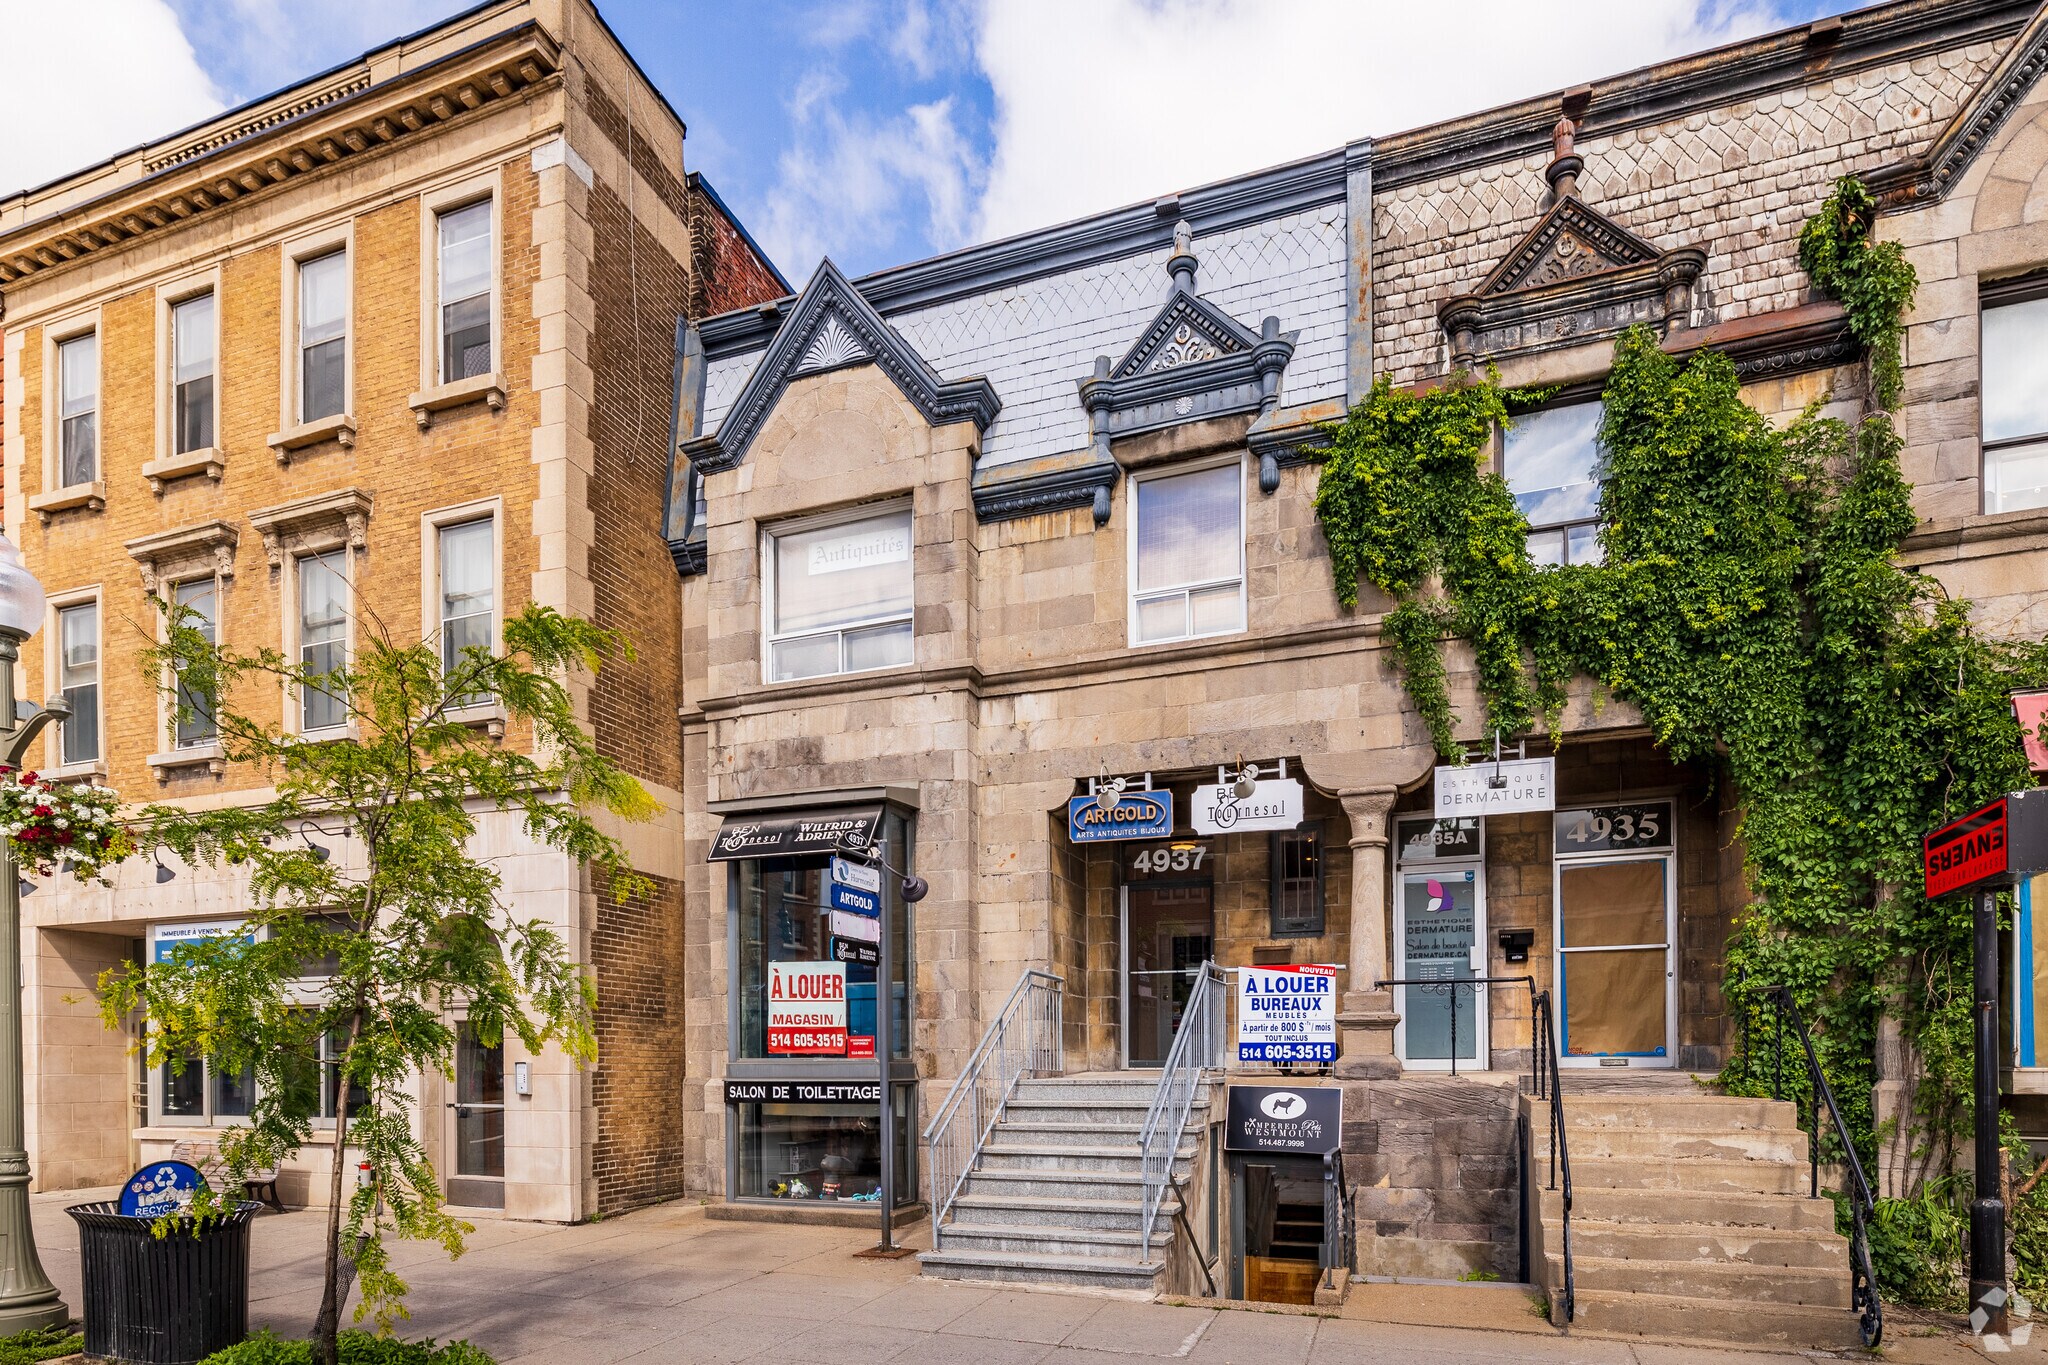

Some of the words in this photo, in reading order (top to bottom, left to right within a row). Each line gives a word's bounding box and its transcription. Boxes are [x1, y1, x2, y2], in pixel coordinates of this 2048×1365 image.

[814, 537, 904, 565] Antiquités
[1443, 773, 1545, 789] ESTHÉQUE
[1216, 787, 1238, 799] BE
[1443, 787, 1546, 806] DERMATURE
[1084, 804, 1157, 824] ARTGOLD
[1207, 800, 1285, 820] Tournesol
[731, 825, 760, 835] BEN
[800, 821, 853, 833] WILFRID
[854, 819, 867, 829] &
[1076, 831, 1094, 839] ARTS
[1140, 826, 1166, 835] BIJOUX
[1566, 813, 1660, 843] 4935
[1409, 830, 1468, 847] 4935A
[1928, 825, 2004, 877] ENVERS
[1133, 847, 1207, 873] 4937
[840, 891, 873, 910] ARTGOLD
[161, 929, 191, 937] IMMEUBLE
[1407, 925, 1473, 935] DERMATURE
[1406, 938, 1430, 951] Salon
[1431, 938, 1440, 950] de
[1407, 951, 1468, 959] DERMATURE.CA
[1299, 966, 1335, 976] NOUVEAU
[770, 968, 783, 999] À
[788, 974, 844, 999] LOUER
[1245, 974, 1258, 993] À
[1264, 976, 1329, 993] LOUER
[1251, 997, 1322, 1011] BUREAUX
[772, 1014, 834, 1025] MAGASIN
[1249, 1023, 1268, 1034] partir
[1270, 1023, 1279, 1032] de
[1281, 1022, 1297, 1032] 800
[1298, 1022, 1305, 1032] $
[1315, 1022, 1331, 1032] mois
[771, 1034, 791, 1047] 514
[793, 1033, 844, 1047] 605-3515
[1241, 1048, 1262, 1059] 514
[1265, 1044, 1332, 1059] 605-3515
[729, 1086, 766, 1099] SALON
[772, 1086, 790, 1099] DE
[796, 1085, 881, 1099] TOILETTAGE
[1244, 1127, 1322, 1139] WESTMOUNT
[1258, 1138, 1305, 1148] 514.487.9998
